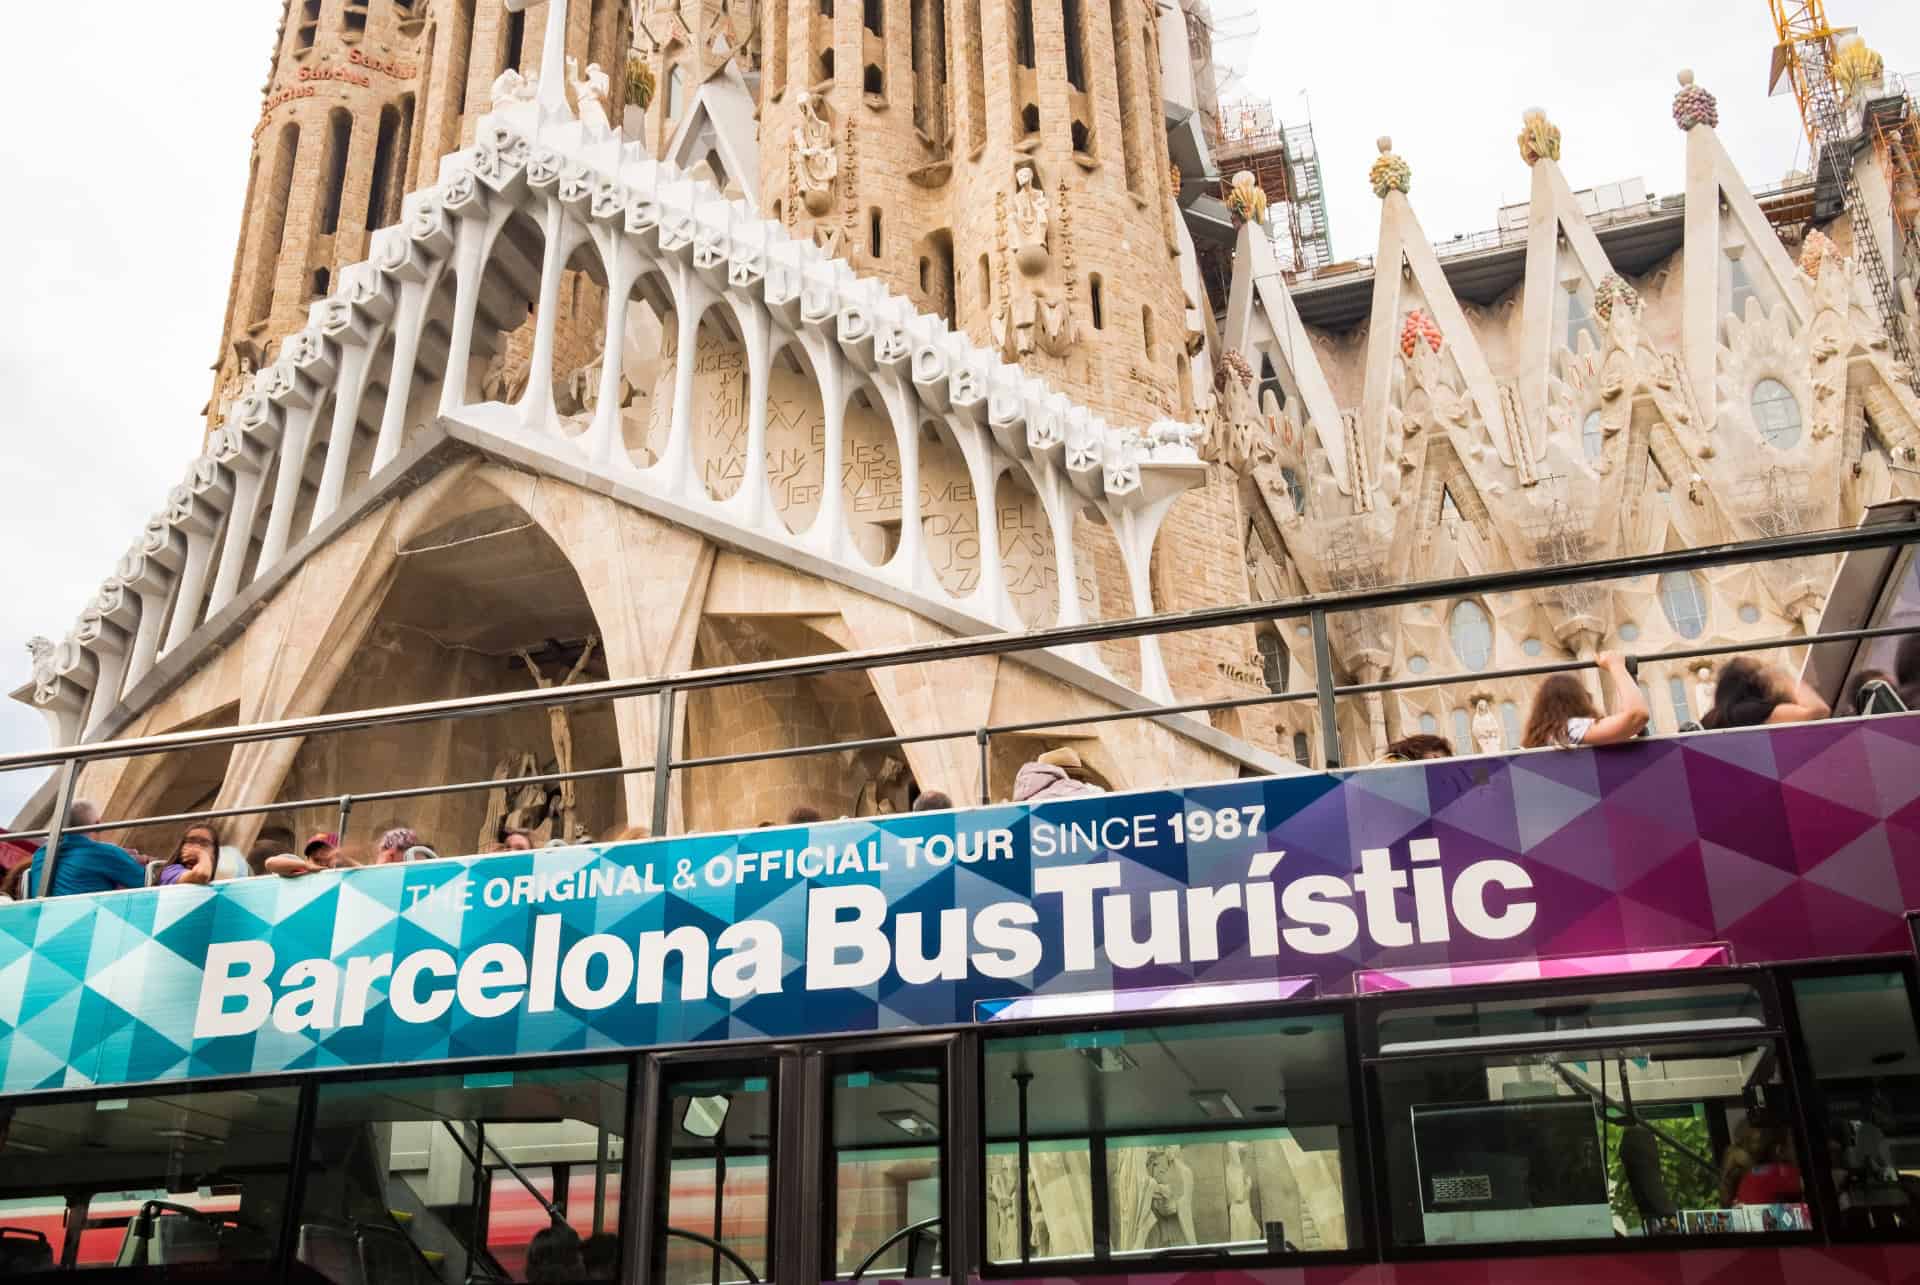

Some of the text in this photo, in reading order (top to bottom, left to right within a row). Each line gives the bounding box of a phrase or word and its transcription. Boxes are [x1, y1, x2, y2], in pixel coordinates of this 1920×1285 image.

[408, 804, 1266, 912] THE ORIGINAL & OFFICIAL TOUR SINCE 1987
[194, 838, 1538, 1039] Barcelona BusTurístic
